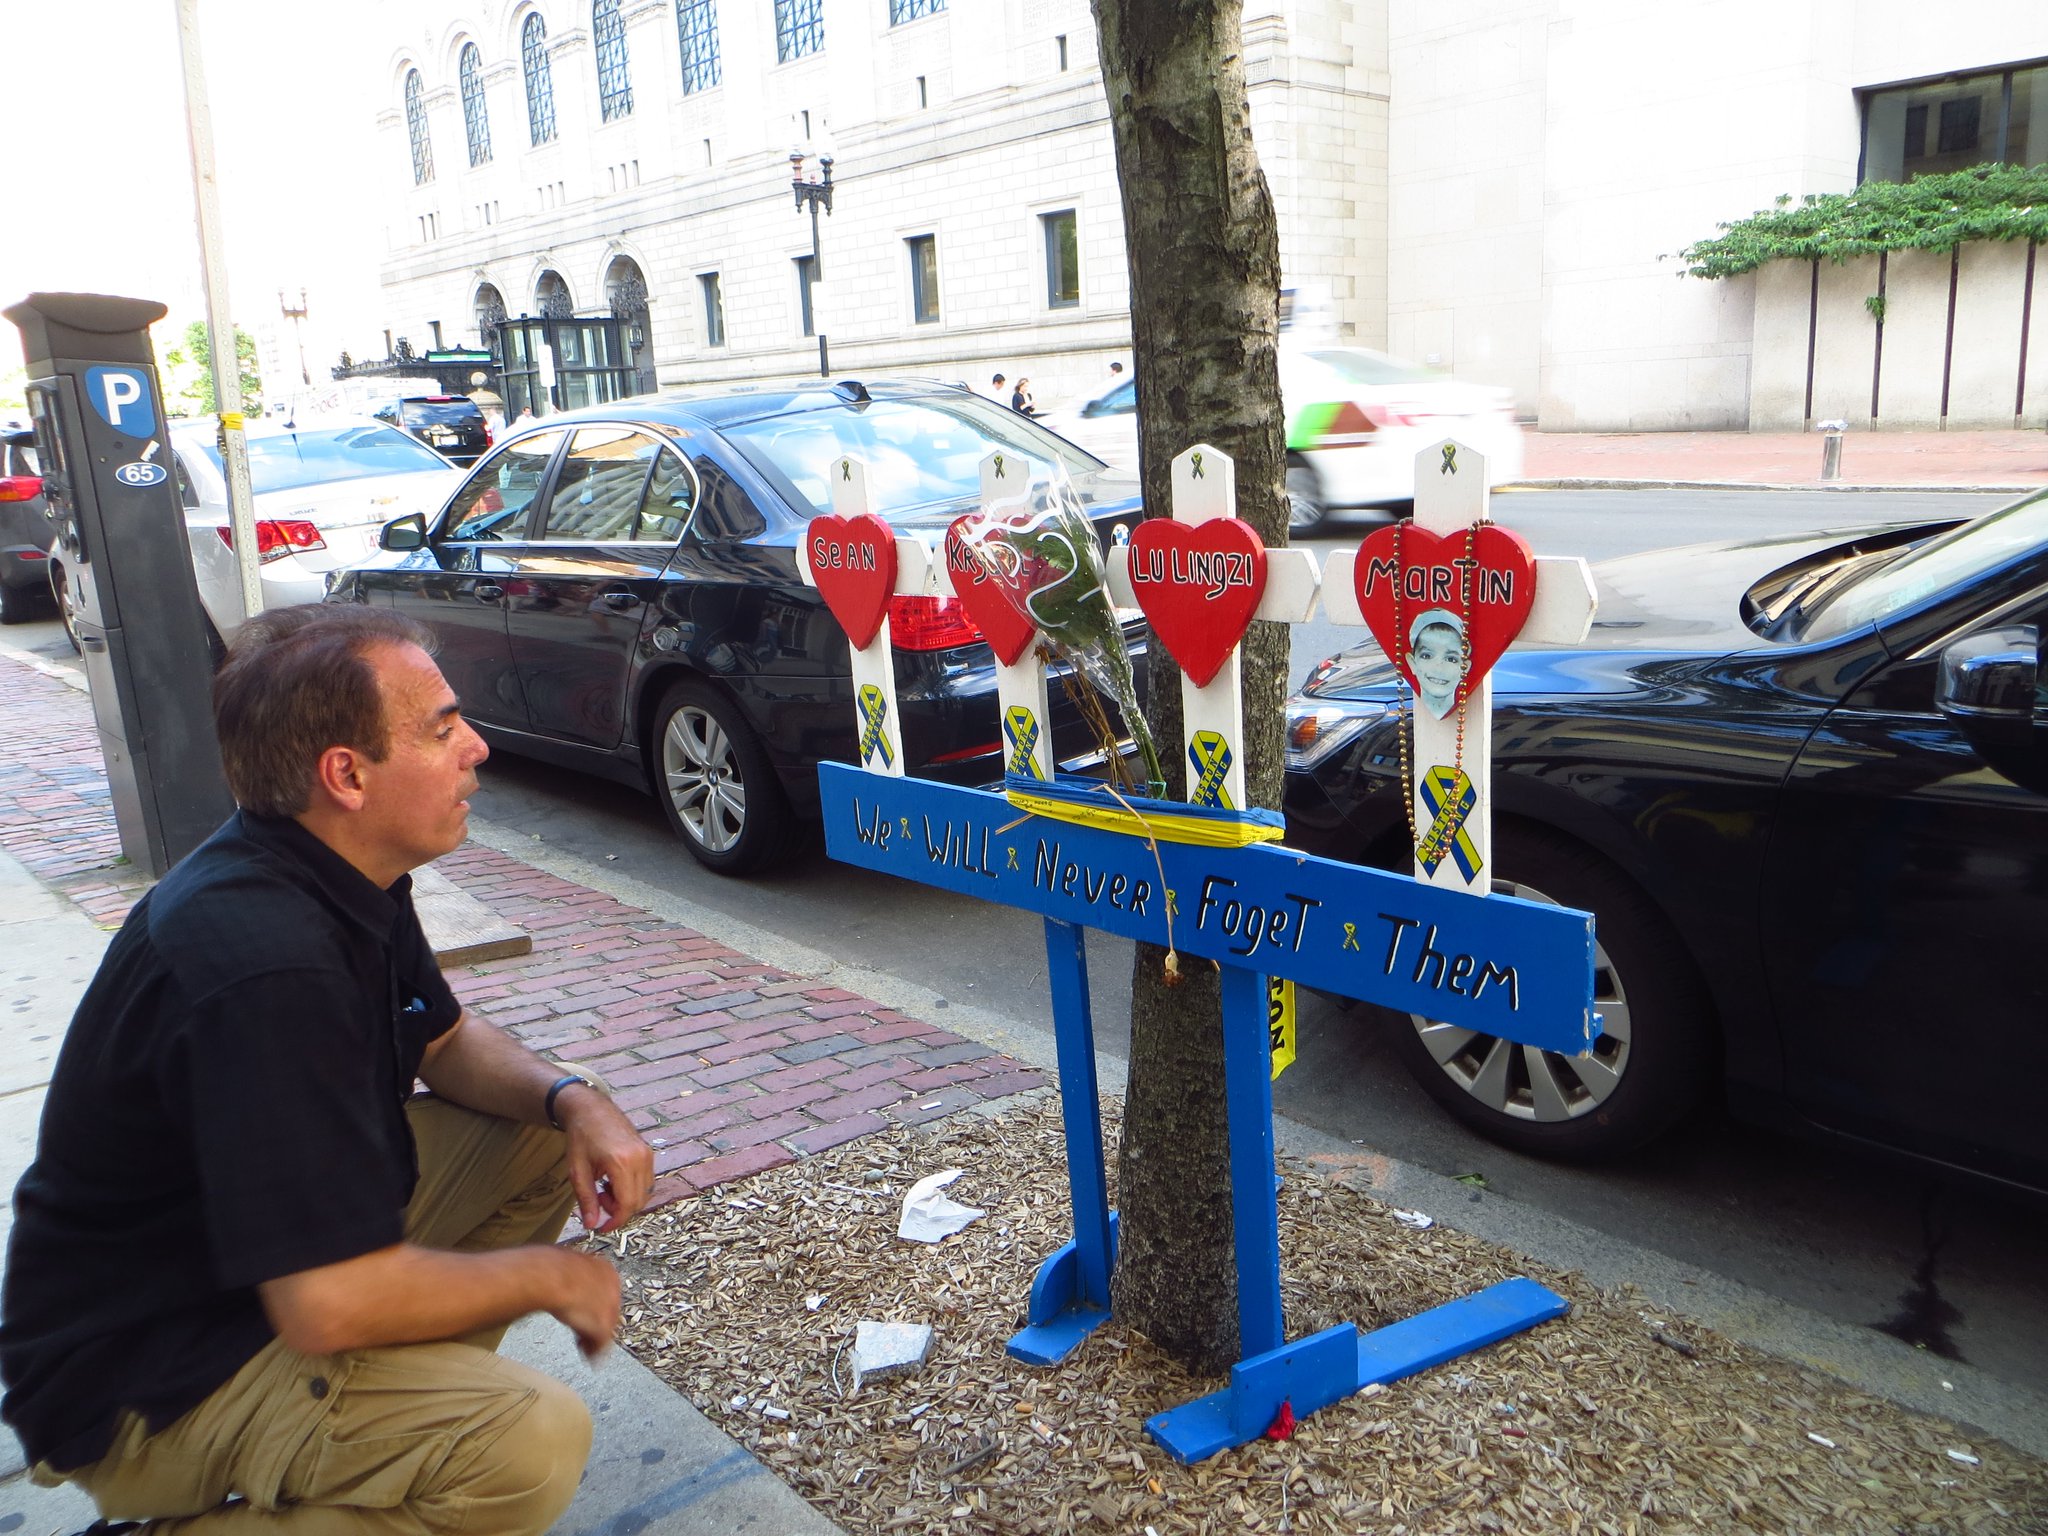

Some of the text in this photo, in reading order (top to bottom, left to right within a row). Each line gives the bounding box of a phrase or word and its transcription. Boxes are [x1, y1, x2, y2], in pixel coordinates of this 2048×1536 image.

[102, 373, 141, 425] P
[125, 466, 155, 483] 65
[1132, 544, 1165, 583] LU
[854, 797, 892, 851] We
